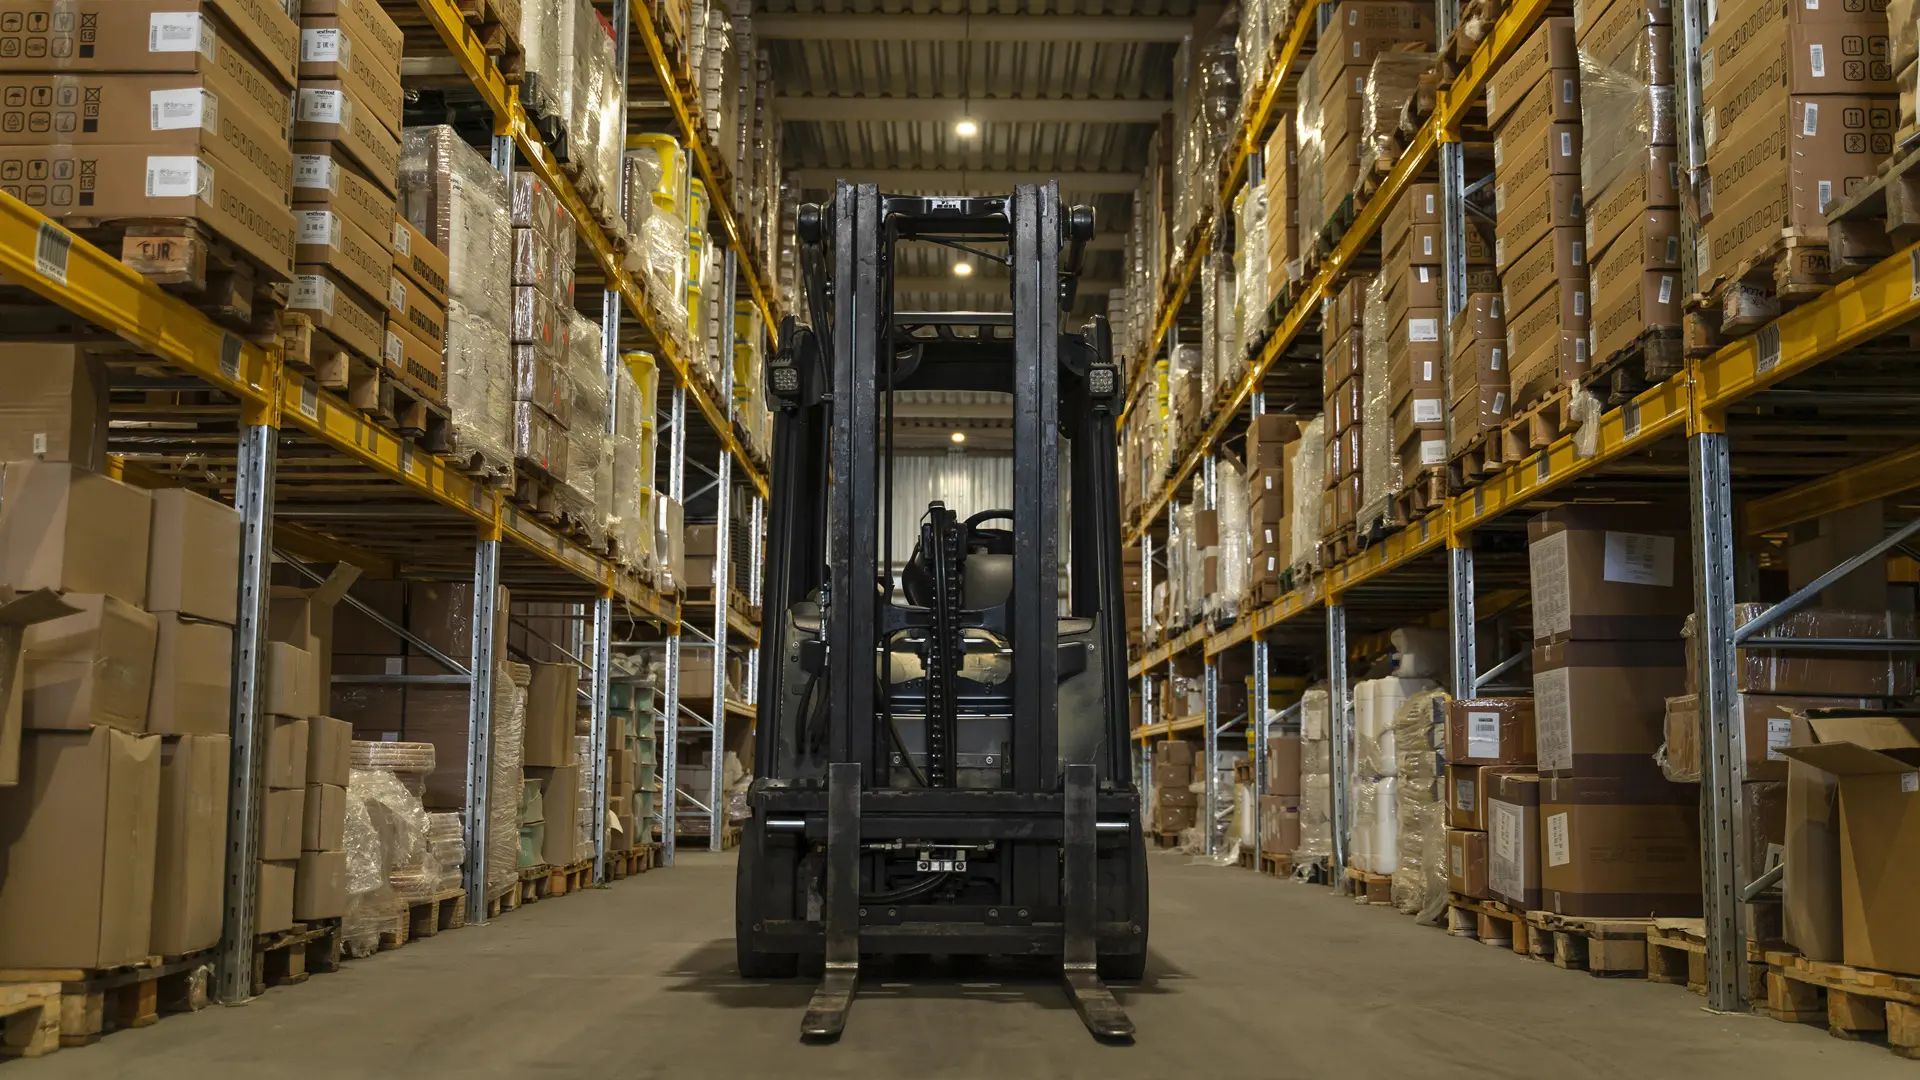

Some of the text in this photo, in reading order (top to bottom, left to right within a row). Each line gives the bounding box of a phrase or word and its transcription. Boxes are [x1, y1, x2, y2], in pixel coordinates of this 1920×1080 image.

[82, 31, 94, 40] 15
[86, 106, 97, 114] 15
[82, 179, 93, 187] 15
